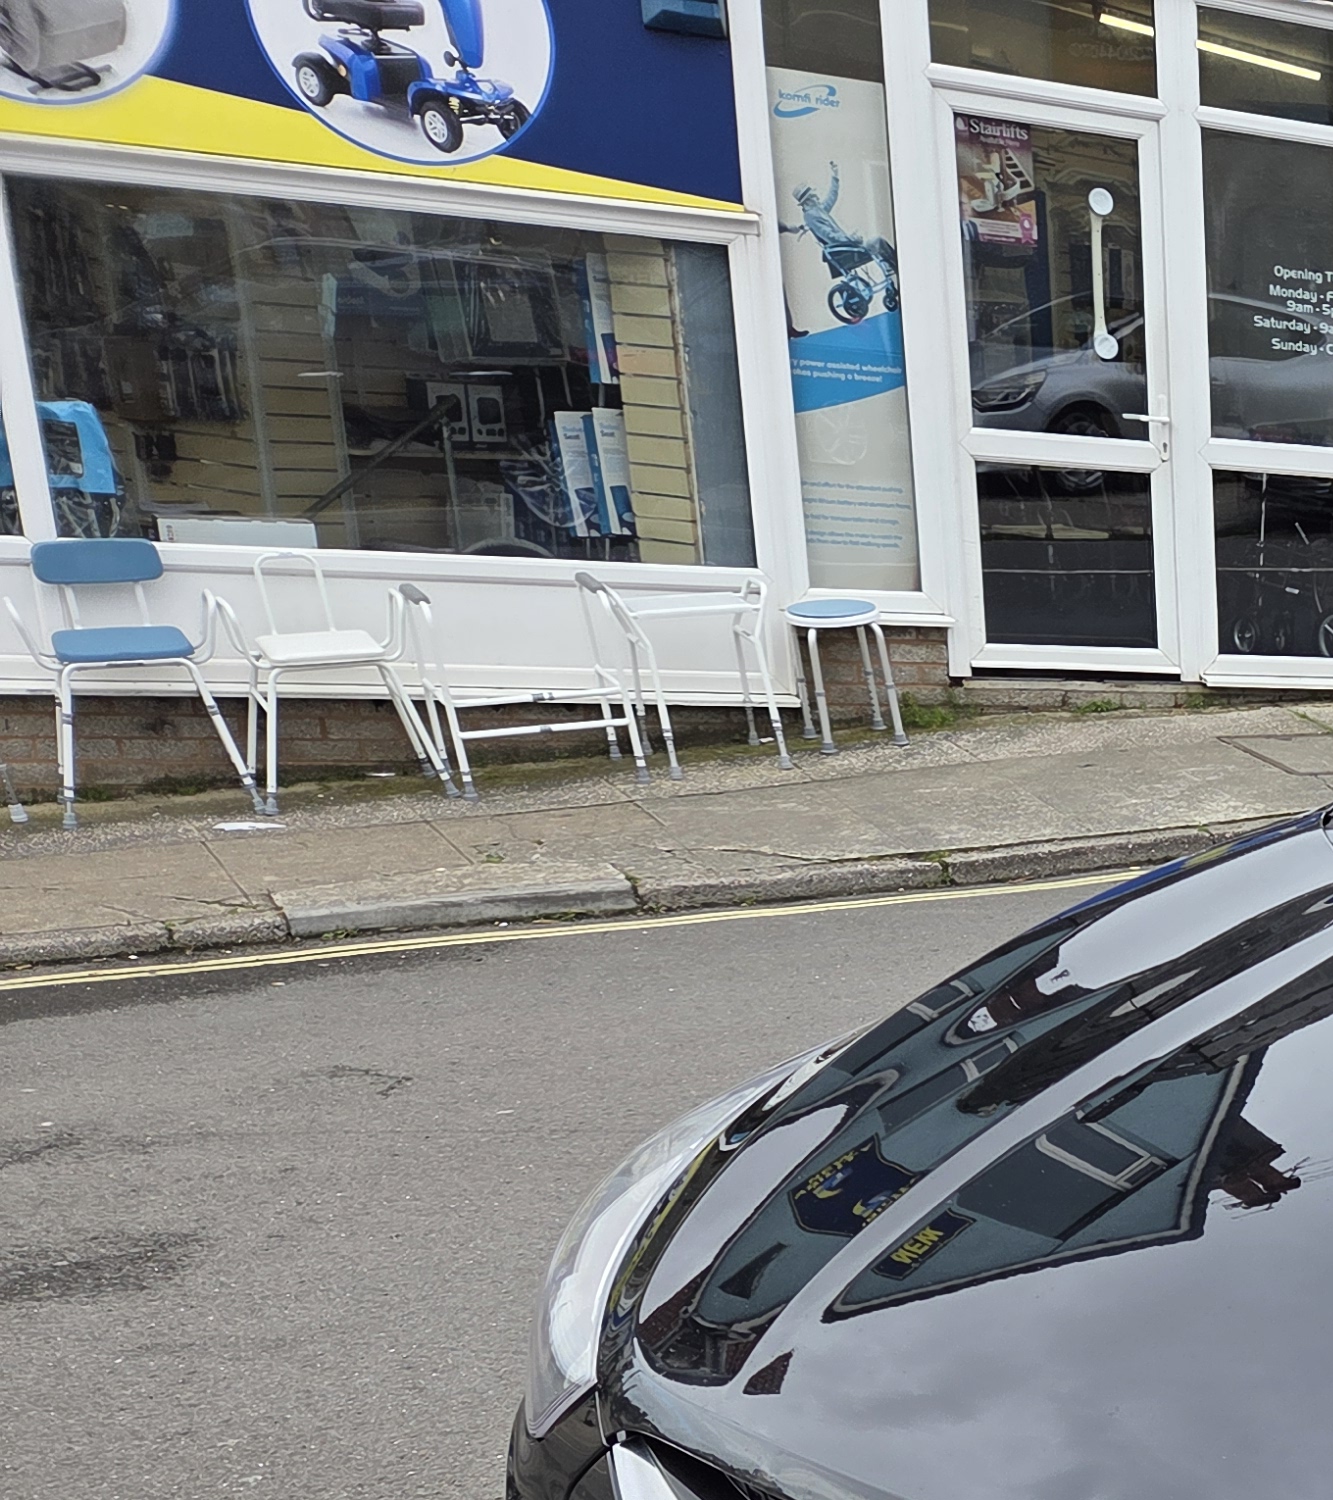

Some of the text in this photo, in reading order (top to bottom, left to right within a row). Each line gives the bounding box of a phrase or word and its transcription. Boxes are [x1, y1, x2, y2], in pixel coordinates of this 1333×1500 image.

[969, 118, 1029, 141] Stairlifts
[1273, 265, 1323, 285] Opening
[1268, 283, 1318, 303] Monday
[1286, 300, 1314, 314] 9am
[1253, 315, 1311, 334] Saturday
[1270, 337, 1318, 356] Sunday
